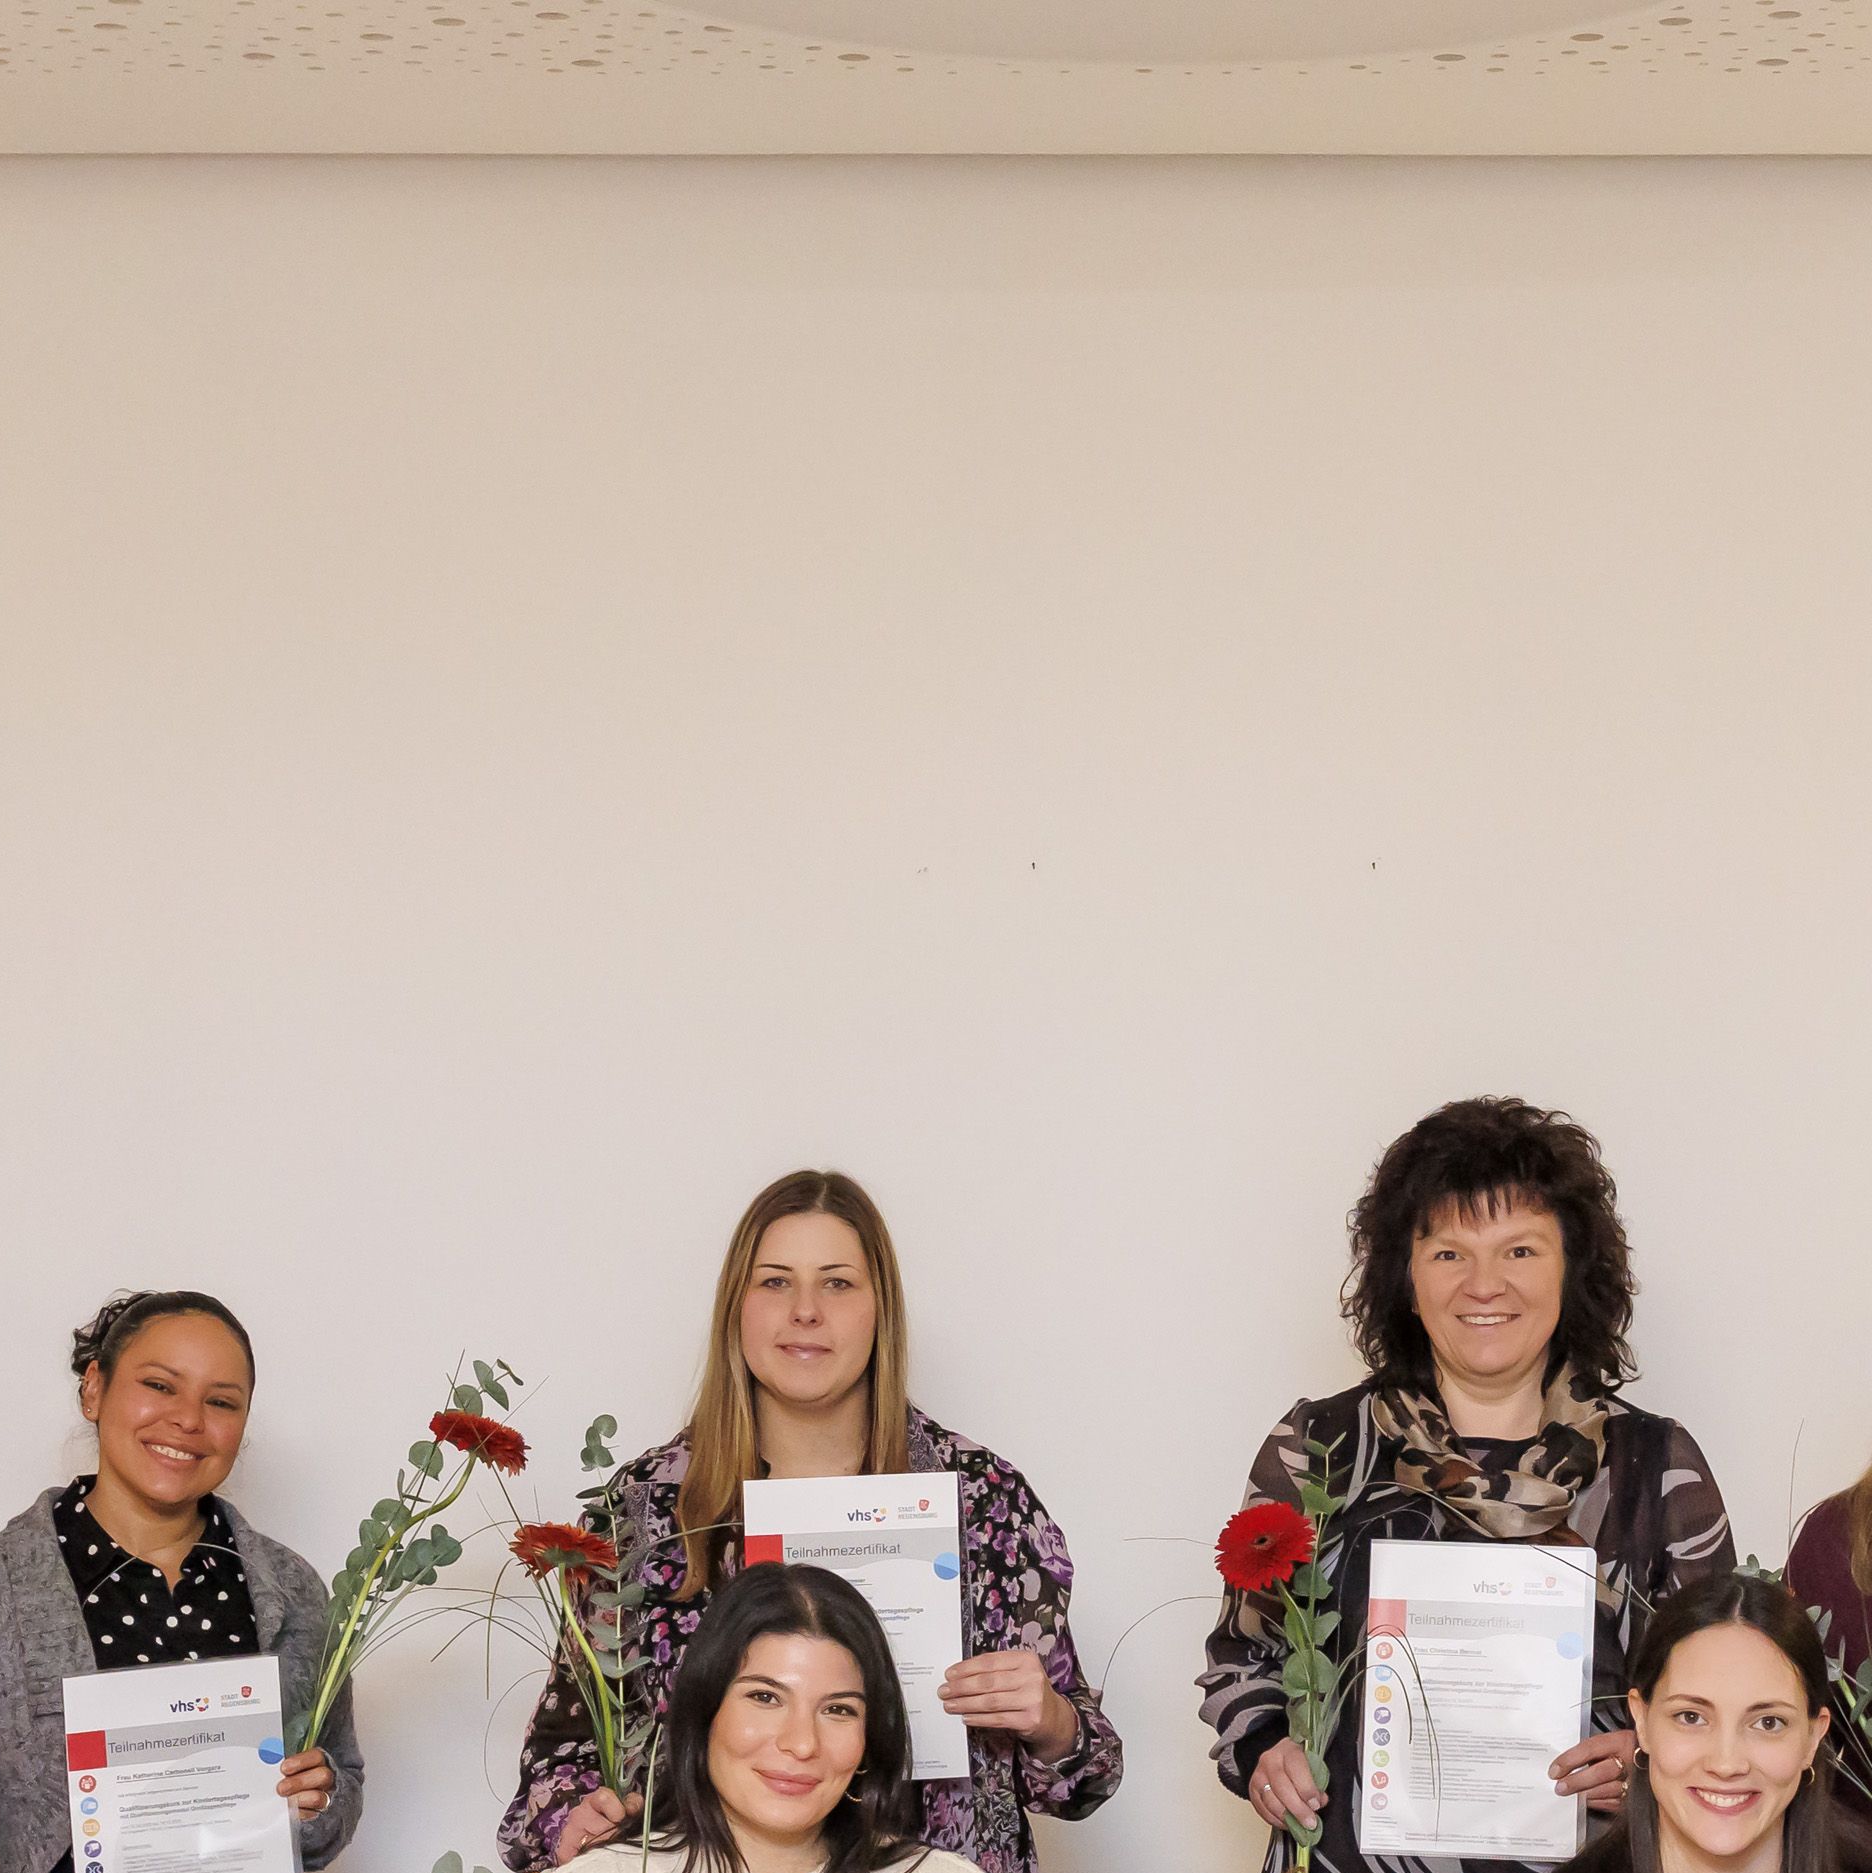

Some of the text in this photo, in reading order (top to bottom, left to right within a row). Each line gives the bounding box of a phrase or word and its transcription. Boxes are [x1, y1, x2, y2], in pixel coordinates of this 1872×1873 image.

[847, 1508, 871, 1522] vhs
[784, 1543, 902, 1559] Teilnahmezertifikat
[1473, 1580, 1497, 1594] vhs
[1408, 1613, 1525, 1630] Teilnahmezertifikat
[170, 1699, 195, 1713] vhs
[109, 1731, 225, 1754] Teilnahmezertifikat
